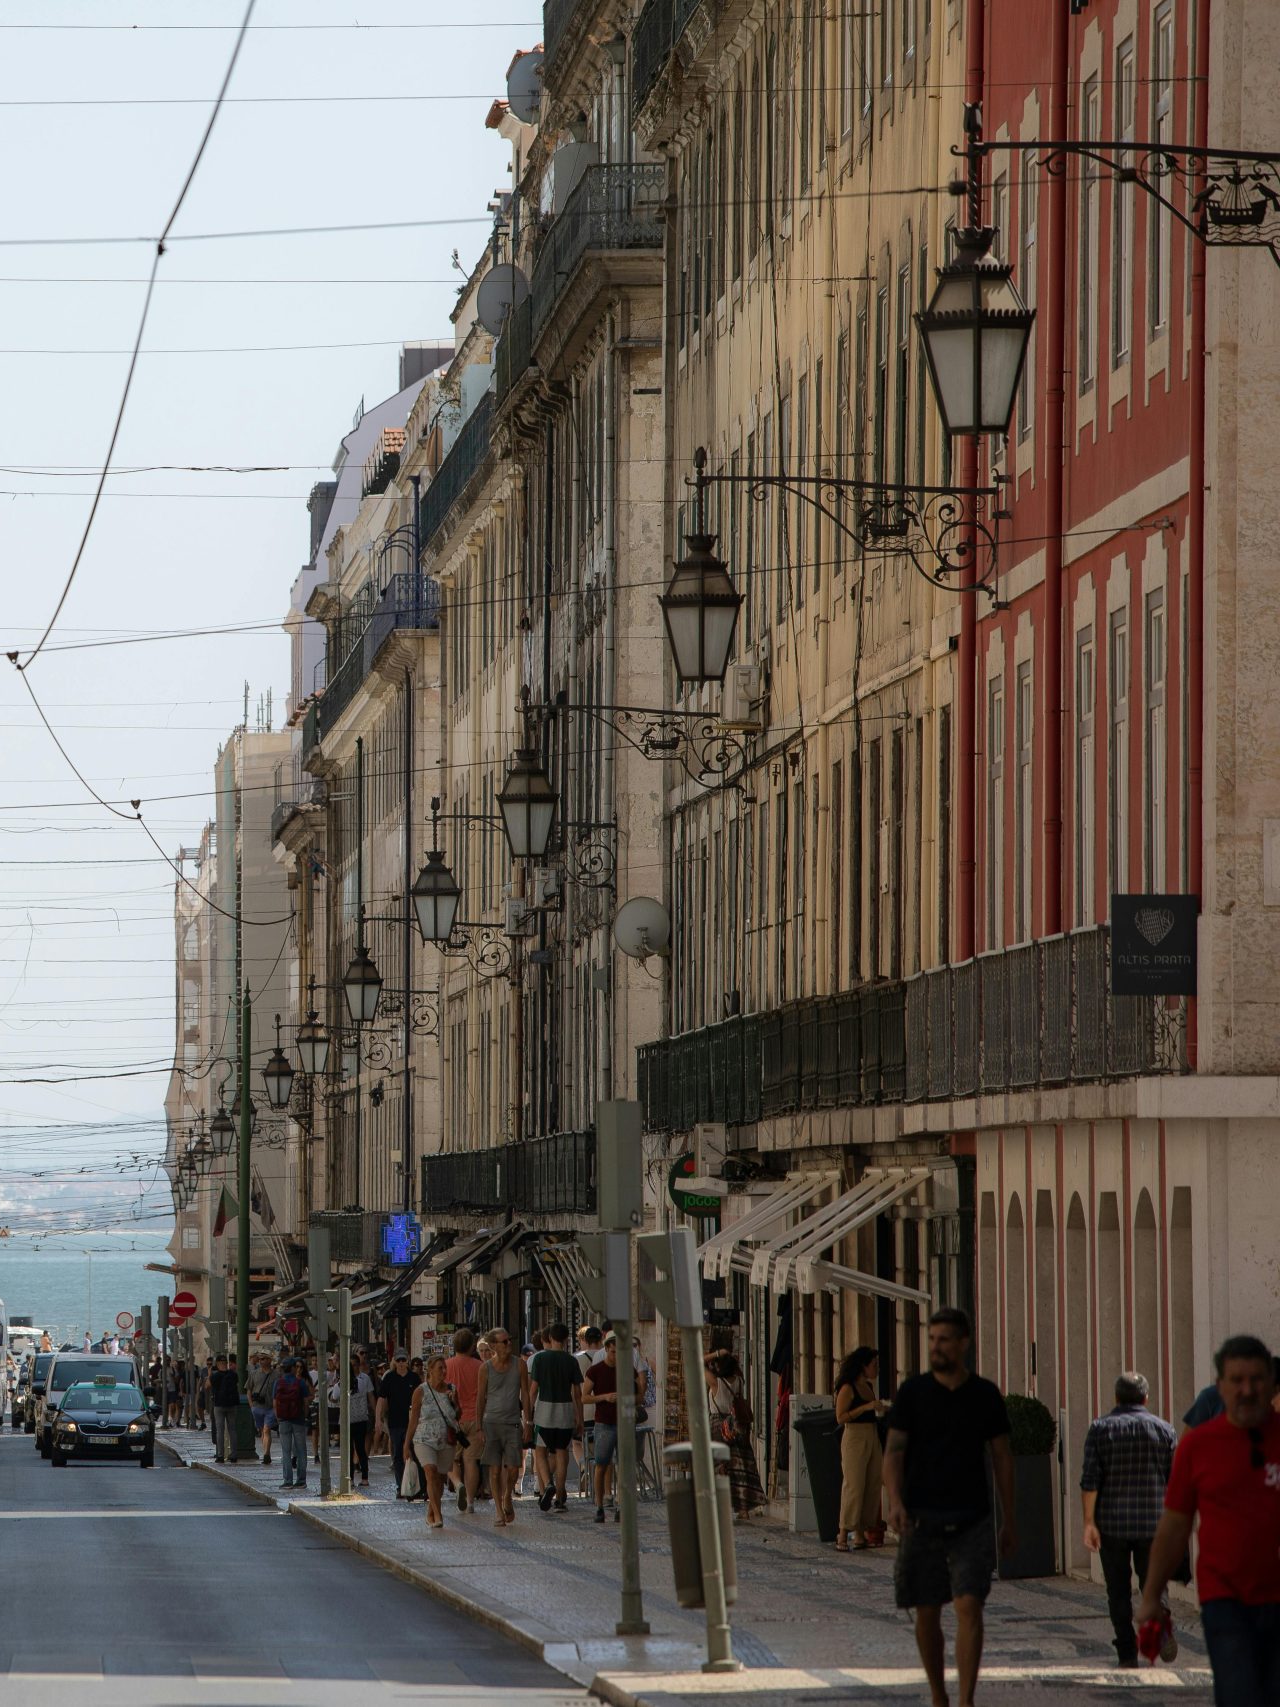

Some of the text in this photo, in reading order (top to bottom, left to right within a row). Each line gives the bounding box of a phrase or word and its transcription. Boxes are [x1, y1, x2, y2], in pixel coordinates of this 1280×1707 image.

[1118, 954, 1192, 966] ALTIS PRATA
[684, 1195, 721, 1210] JOGOS
